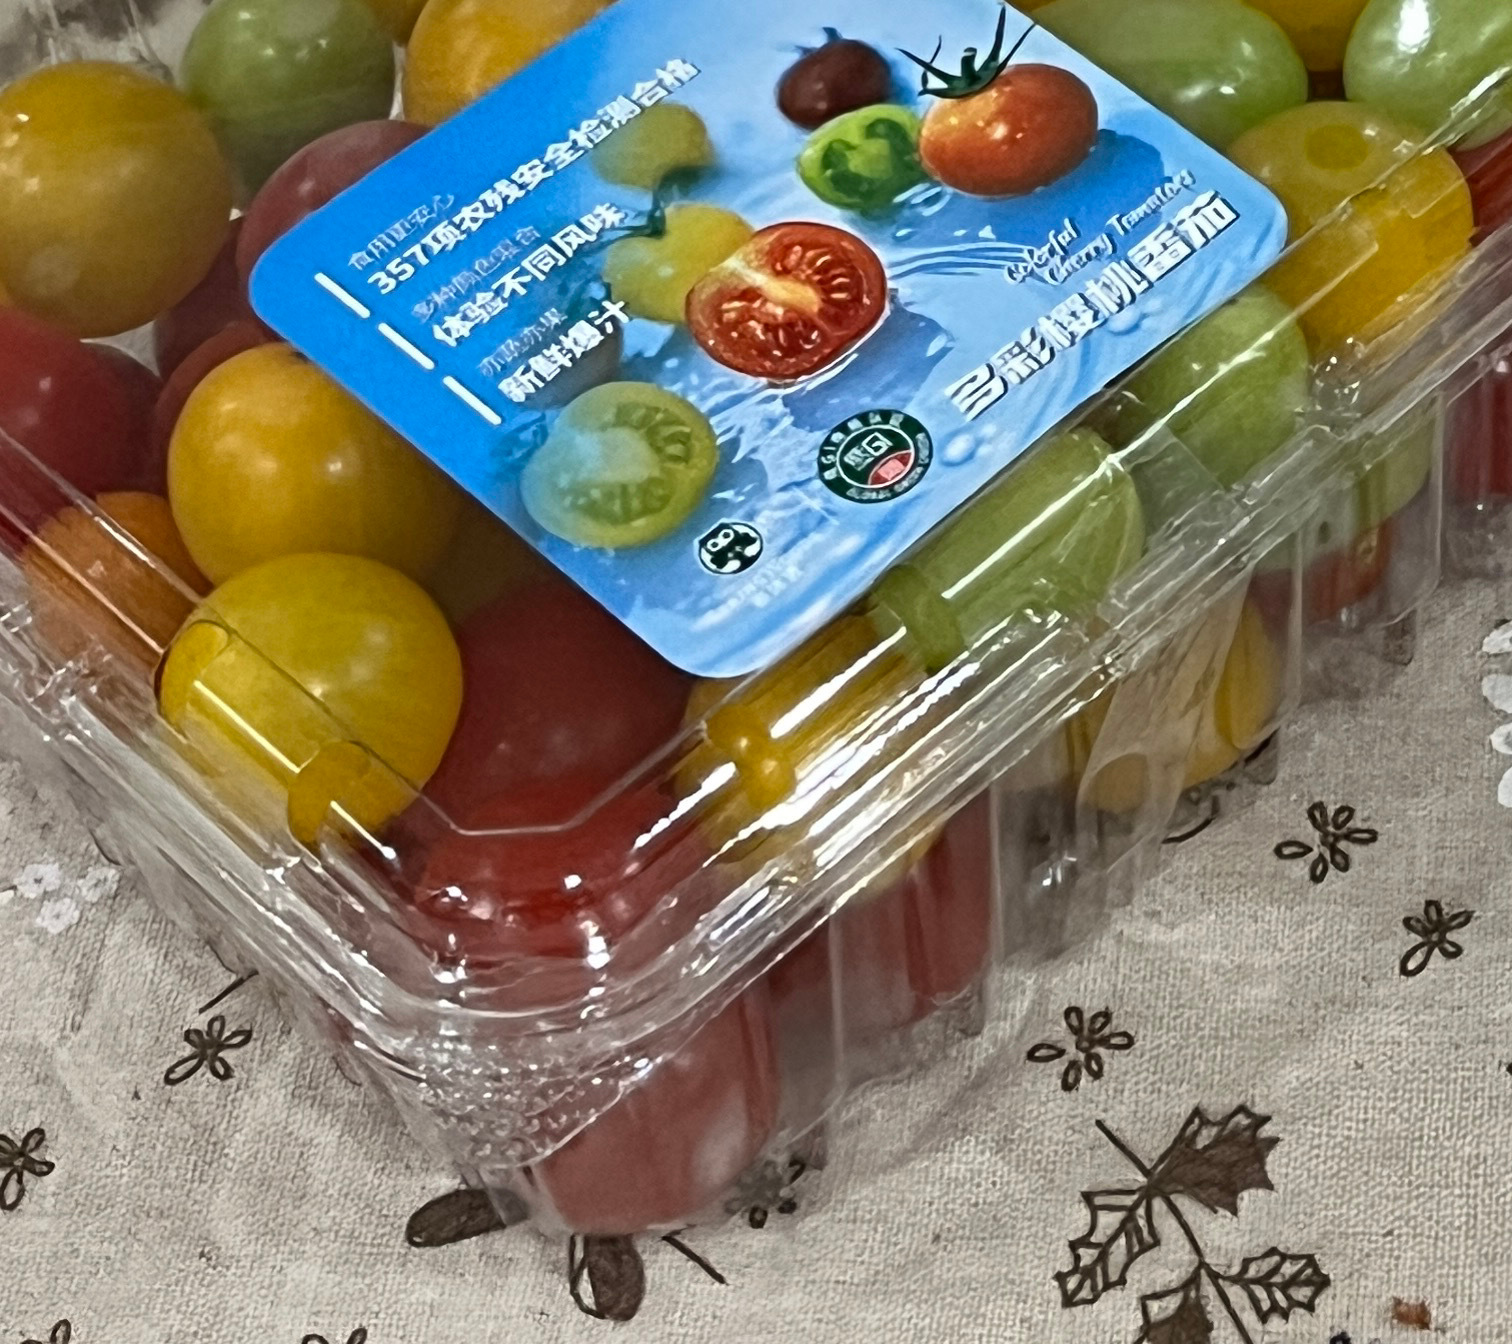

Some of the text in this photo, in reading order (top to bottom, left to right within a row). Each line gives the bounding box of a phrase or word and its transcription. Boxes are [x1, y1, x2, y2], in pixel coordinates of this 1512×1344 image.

[367, 58, 701, 295] 357项农残安全检测合格
[432, 202, 627, 347] 体验不同风味
[497, 299, 630, 403] 新鲜爆汁
[944, 188, 1241, 423] 多彩樱桃番茄
